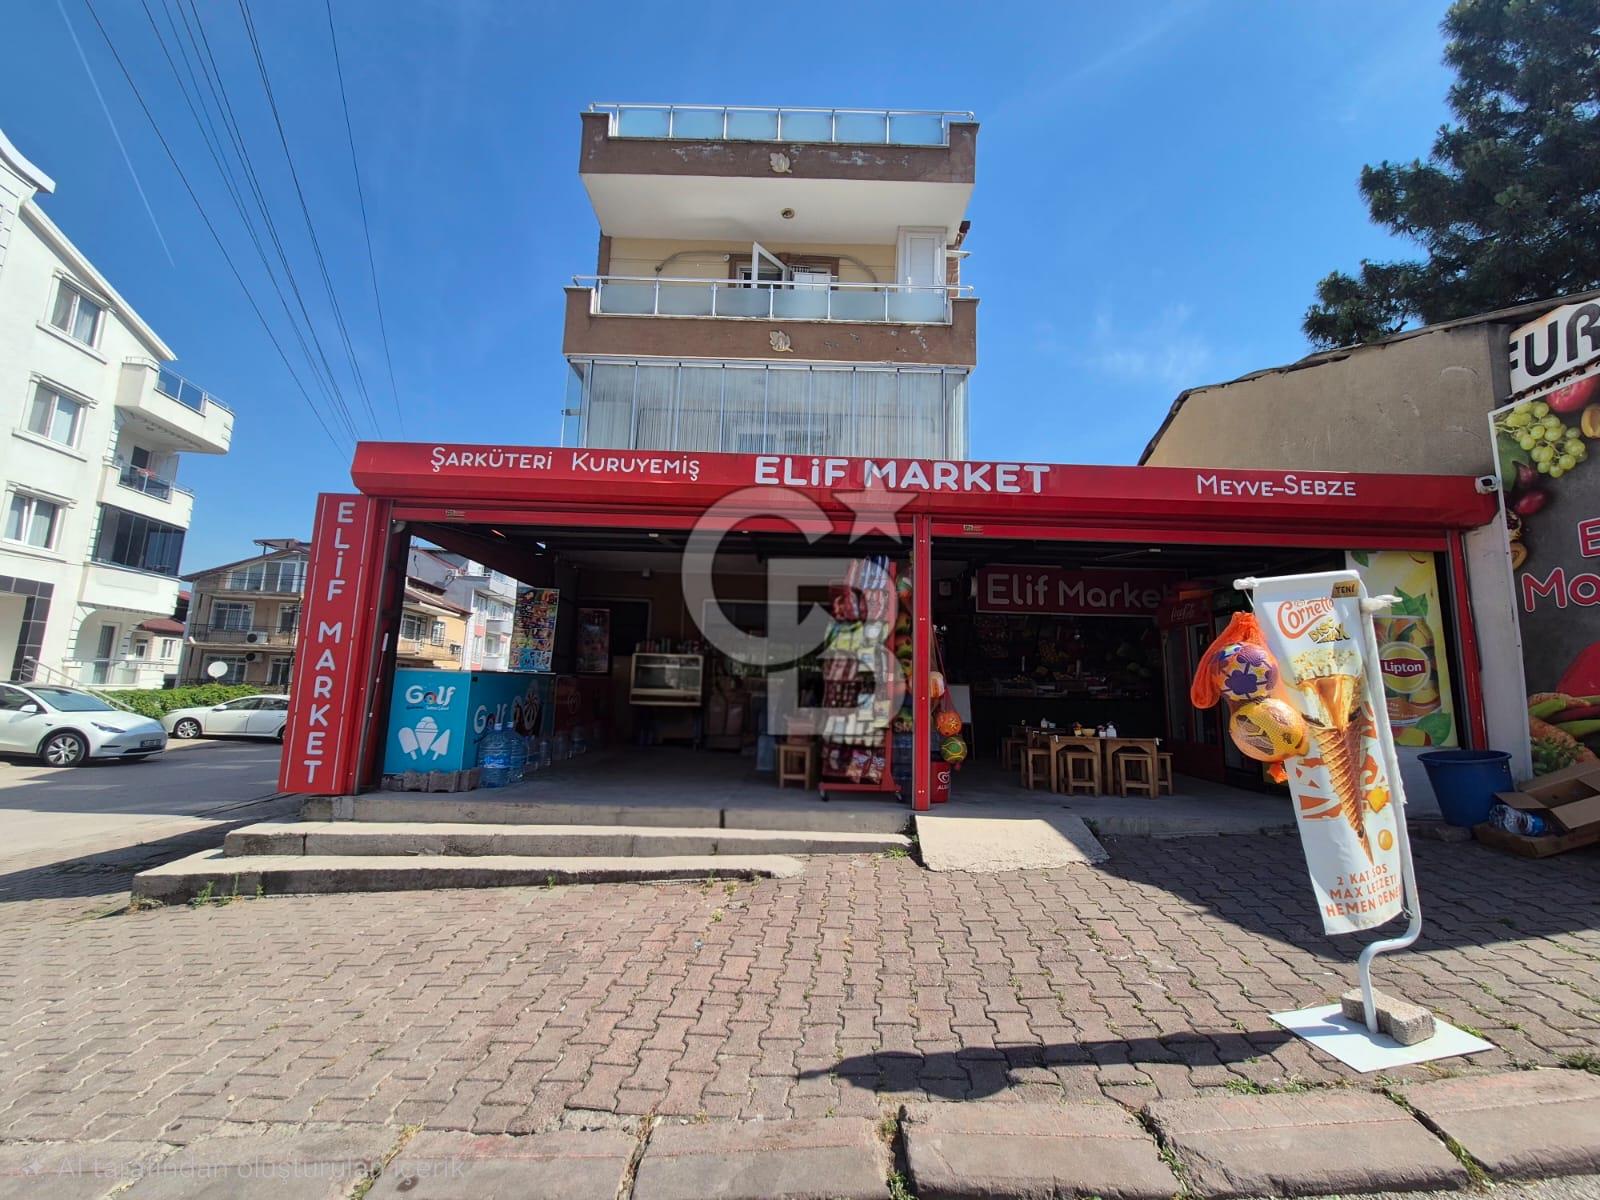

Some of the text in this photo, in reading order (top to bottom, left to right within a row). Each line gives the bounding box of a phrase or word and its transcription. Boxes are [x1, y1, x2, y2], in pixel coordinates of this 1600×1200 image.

[864, 459, 1050, 493] MARKET
[987, 573, 1049, 606] Elif
[1277, 597, 1334, 640] Cornetto
[1384, 661, 1422, 674] Lipton
[303, 621, 343, 784] MARKET
[405, 685, 456, 706] Golf
[1329, 885, 1364, 900] MAX
[1326, 898, 1377, 918] HEMEN
